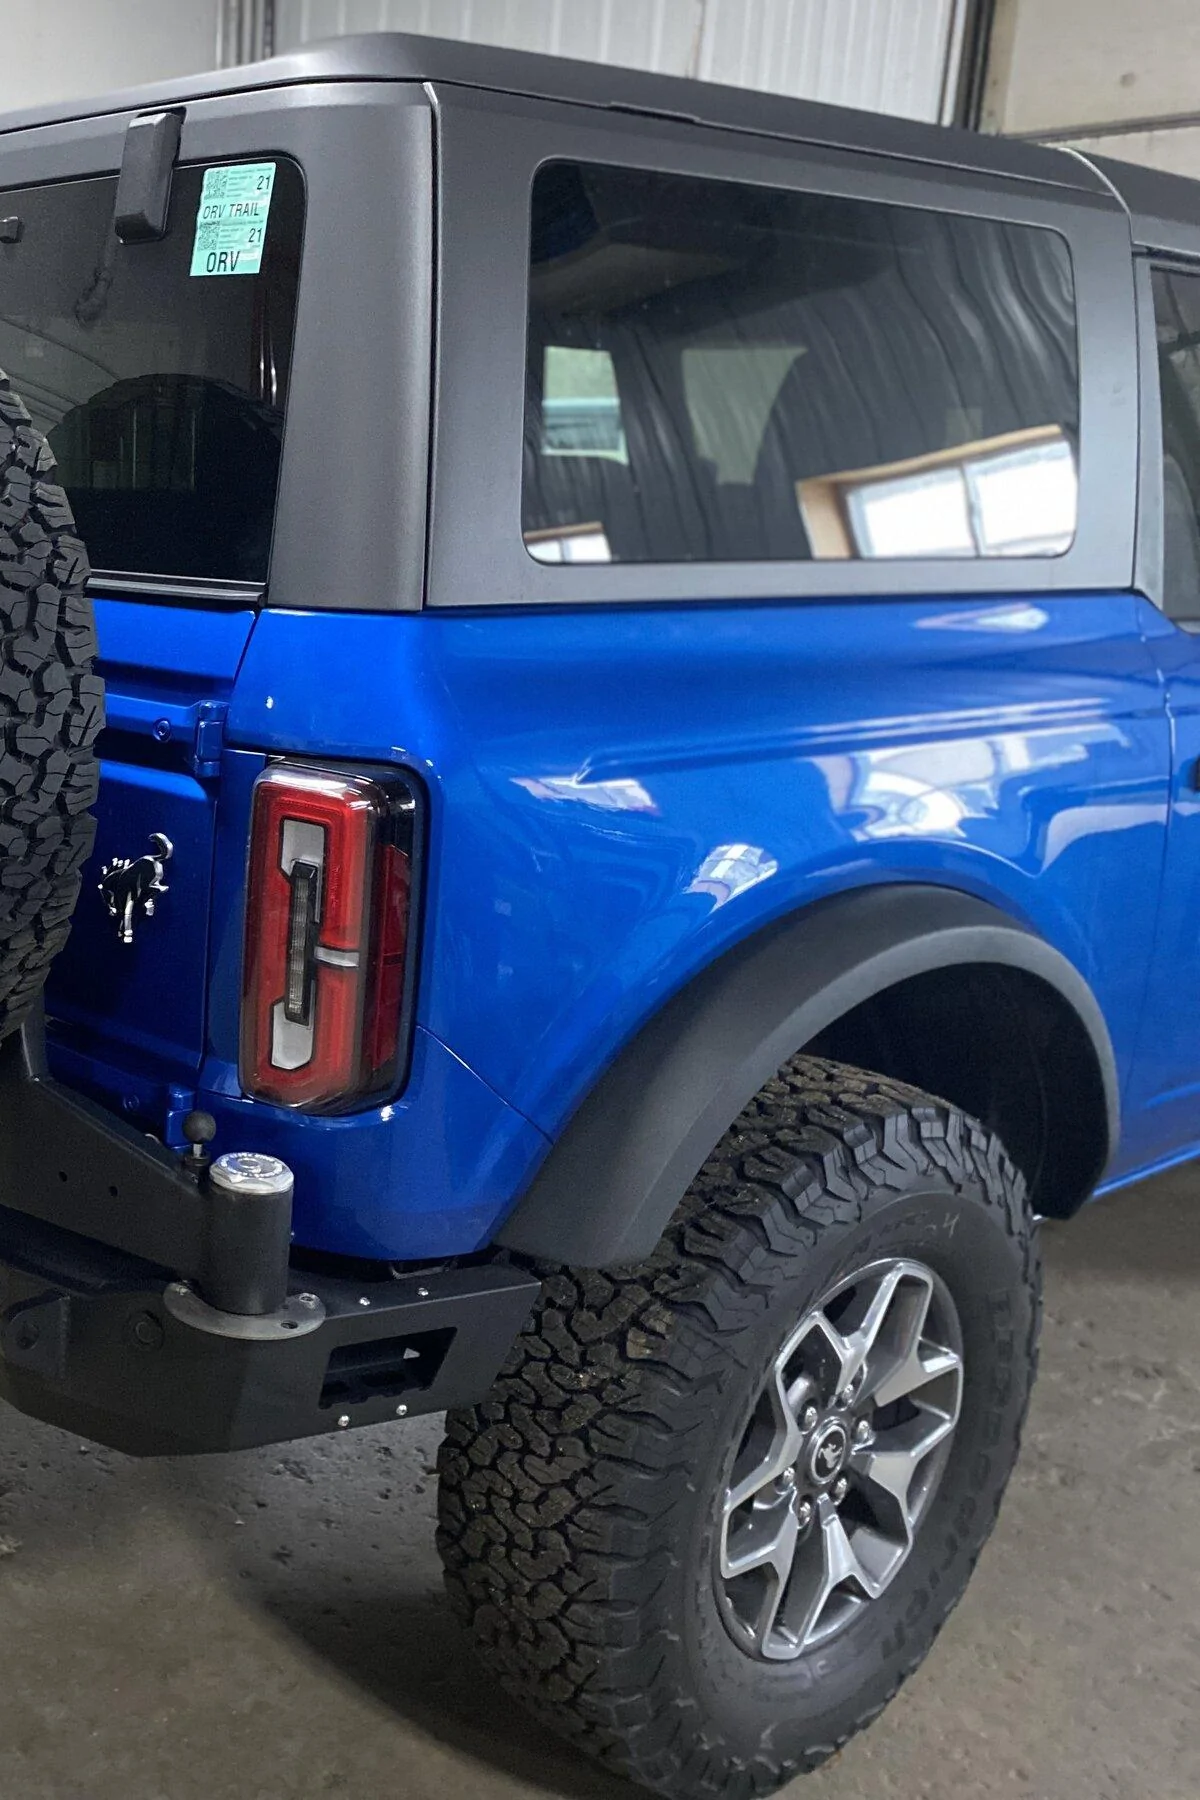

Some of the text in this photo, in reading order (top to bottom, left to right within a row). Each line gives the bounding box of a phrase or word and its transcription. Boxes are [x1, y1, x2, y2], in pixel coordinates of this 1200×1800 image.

[256, 174, 271, 191] 21
[203, 202, 260, 220] ORV TRAIL
[248, 227, 263, 243] 21
[206, 250, 240, 273] ORV
